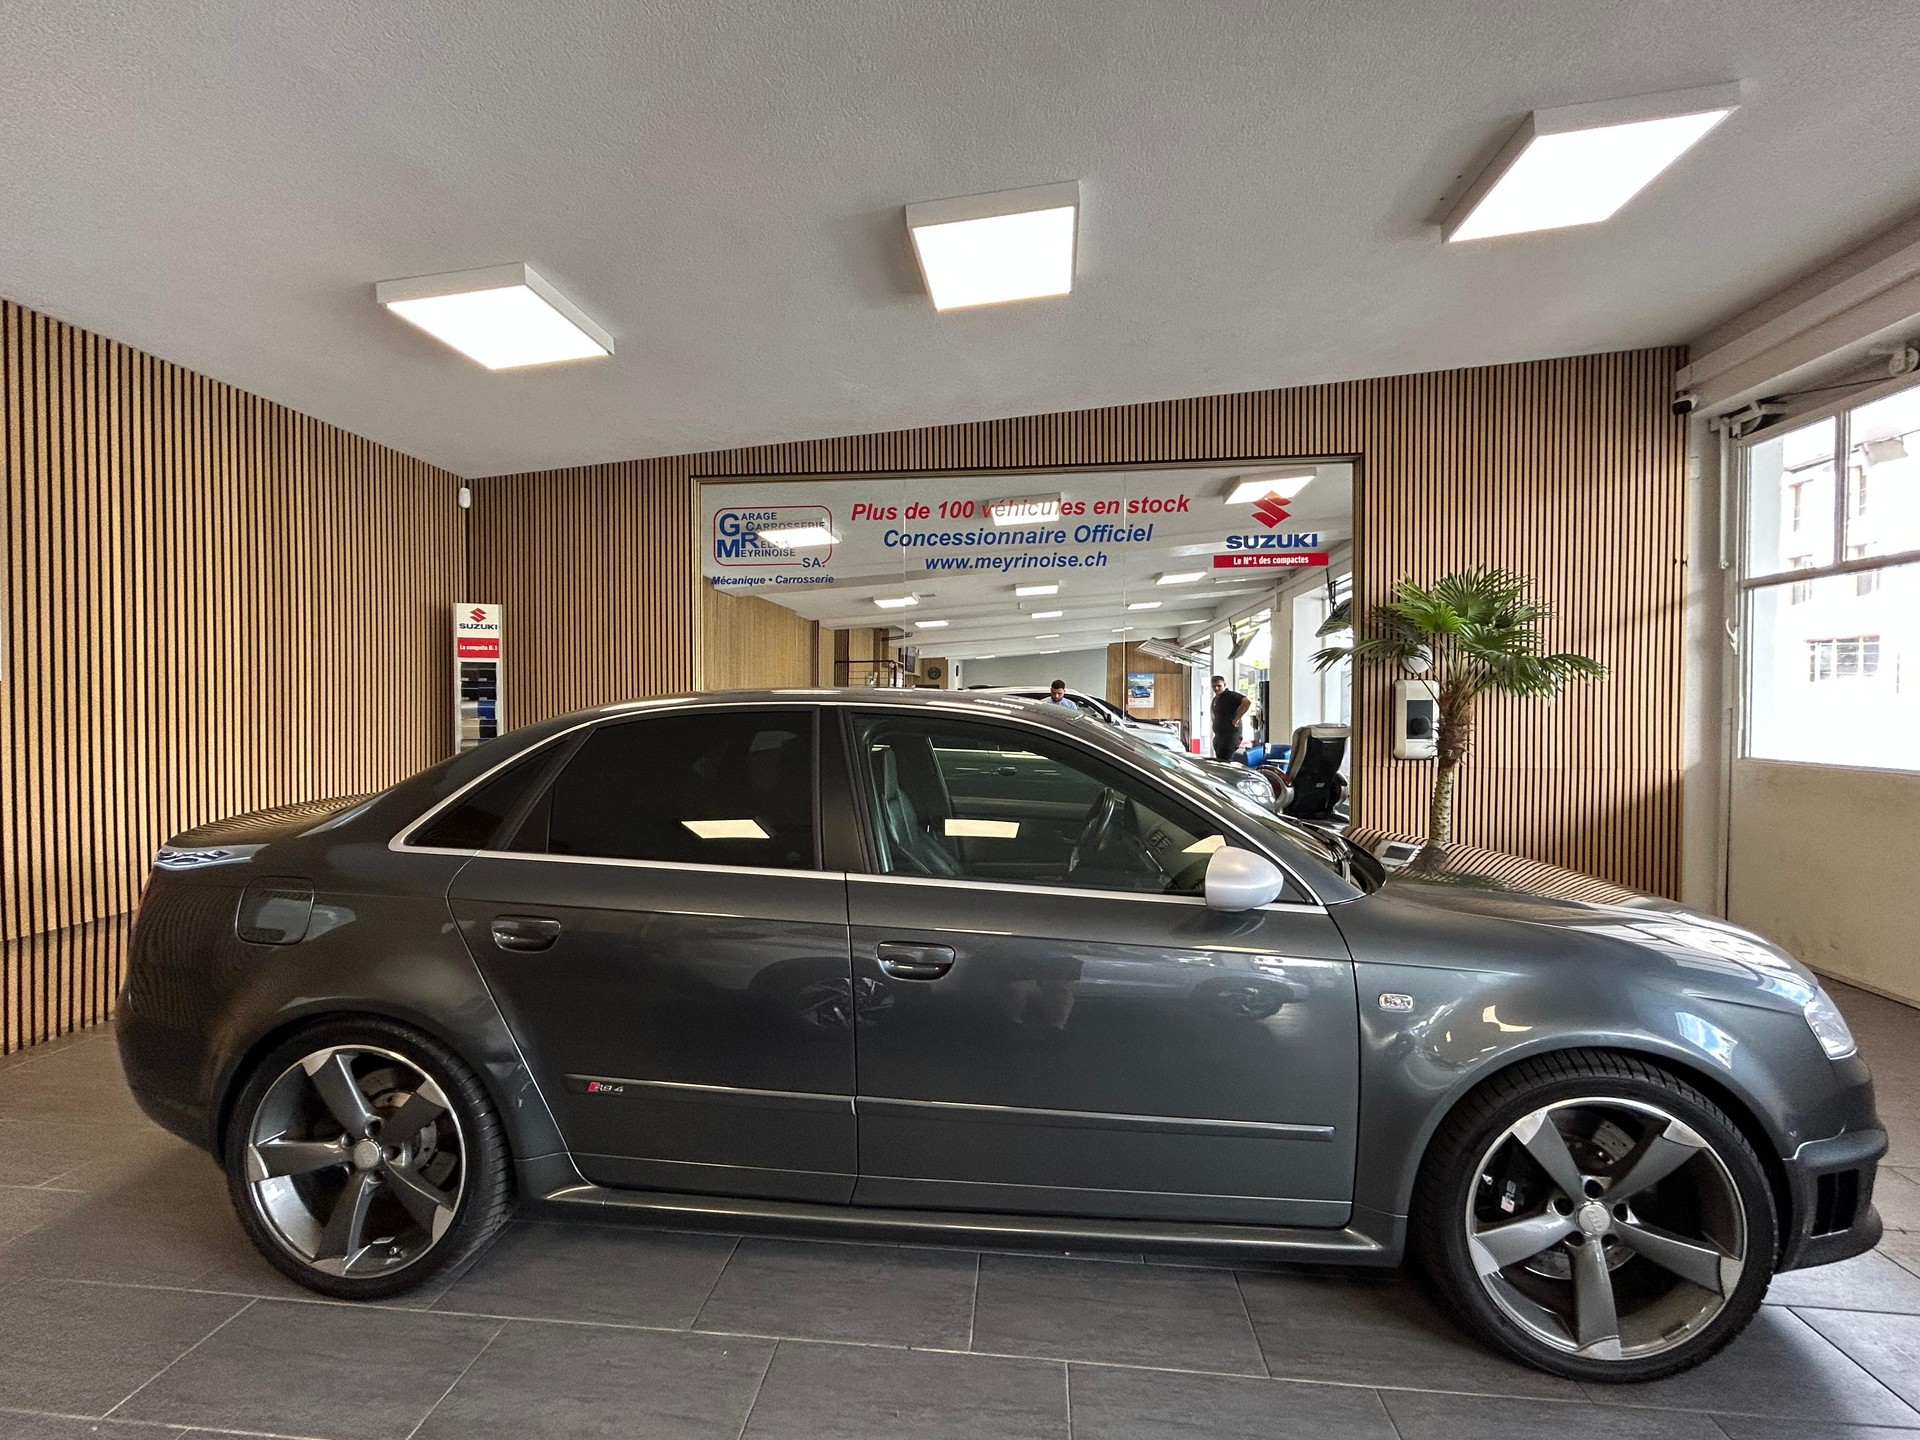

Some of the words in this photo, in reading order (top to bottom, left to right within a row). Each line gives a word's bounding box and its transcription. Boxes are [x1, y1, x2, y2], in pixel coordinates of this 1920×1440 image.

[851, 503, 898, 521] Plus
[904, 502, 931, 520] de
[938, 500, 975, 519] 100
[982, 498, 1086, 518] véhicules
[1093, 500, 1120, 515] en
[1127, 494, 1191, 514] stock
[719, 512, 777, 537] GARAGE
[884, 526, 1067, 548] Concessionnaire
[1074, 523, 1154, 543] Officiel
[1226, 533, 1318, 549] SUZUKI
[717, 539, 796, 558] MEYRINOISE
[925, 551, 1108, 573] www.meyrinoise.ch
[1233, 556, 1242, 565] Le
[1259, 556, 1271, 565] des
[1272, 555, 1309, 566] compactes
[711, 575, 766, 587] Mécanique
[775, 574, 835, 585] Carrosserie
